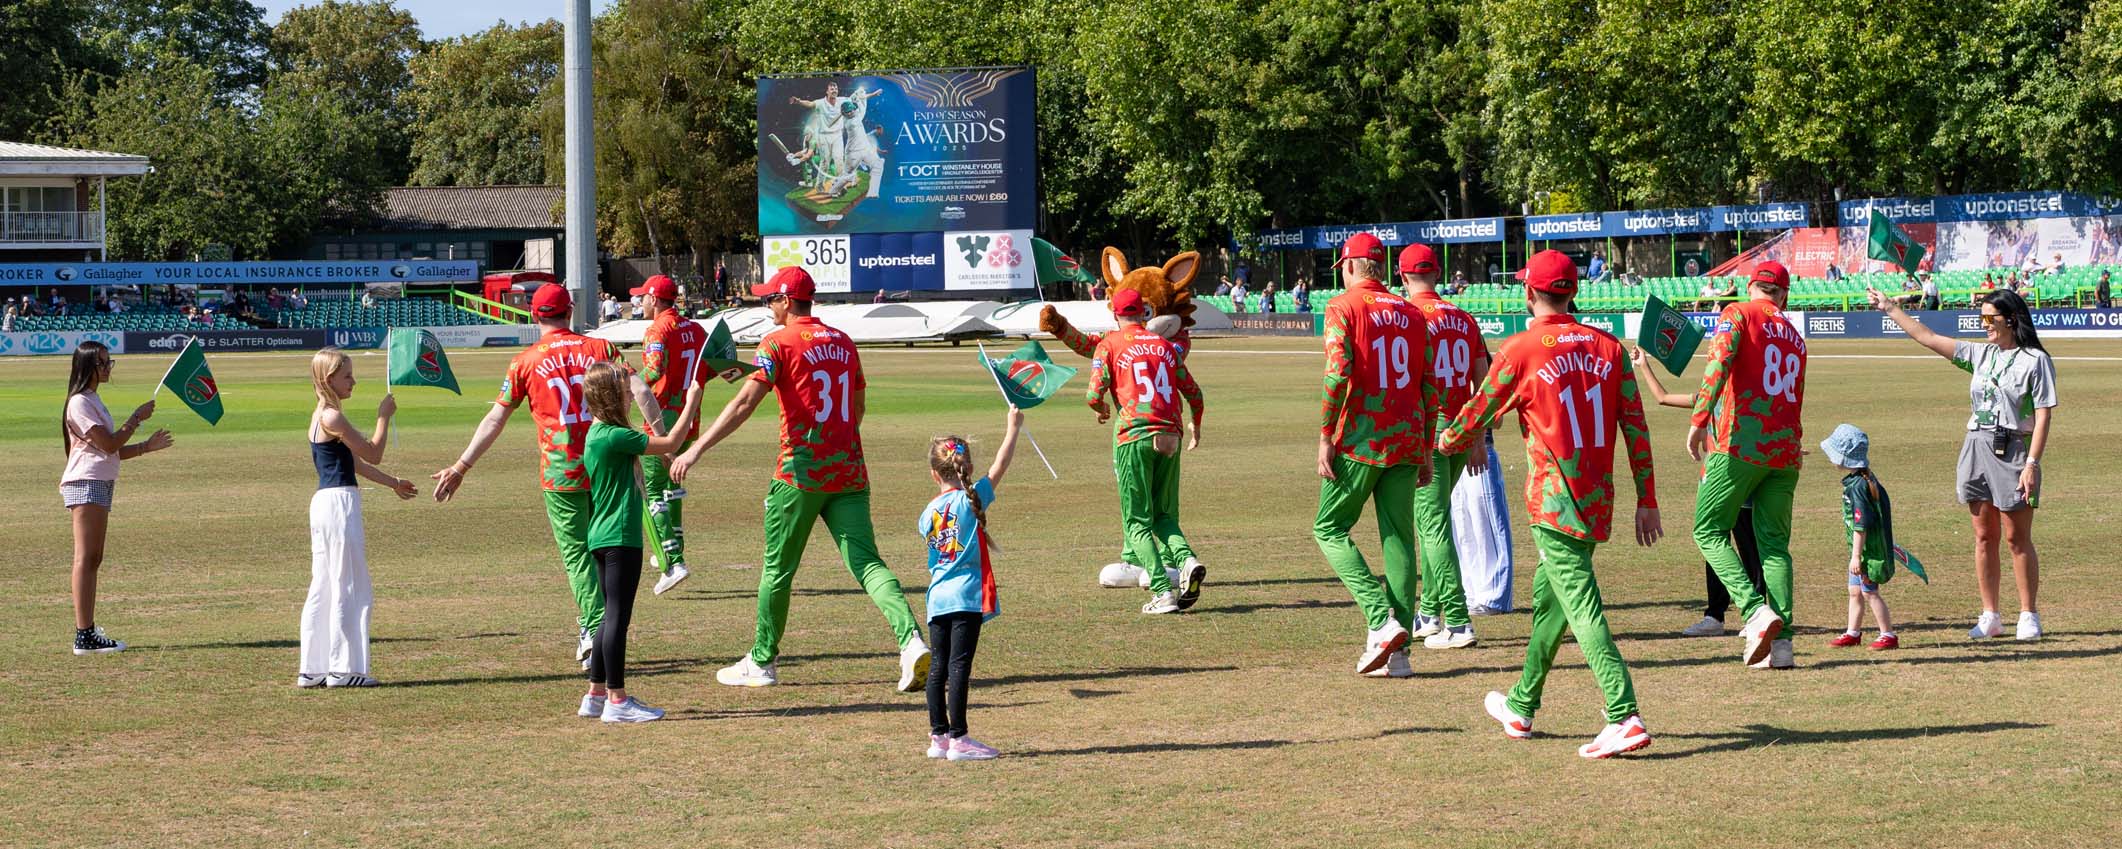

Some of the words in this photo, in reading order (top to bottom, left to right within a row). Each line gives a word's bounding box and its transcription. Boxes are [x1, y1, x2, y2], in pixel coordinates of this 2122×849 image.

[914, 111, 934, 120] END
[947, 110, 986, 120] SEASON
[895, 118, 1006, 145] AWARDS
[909, 164, 941, 177] OCT
[926, 194, 965, 203] AVAILABLE
[989, 193, 1008, 201] £60
[1965, 194, 2063, 217] uptonsteel
[1624, 212, 1699, 231] uptonsteel
[1724, 205, 1804, 227] uptonsteel
[1421, 220, 1497, 241] uptonsteel
[1529, 217, 1601, 237] uptonsteel
[805, 239, 847, 266] 365
[859, 254, 936, 269] uptonsteel
[1795, 251, 1835, 261] ELECTRIC
[83, 268, 143, 282] Gallagher
[155, 267, 191, 279] YOUR
[197, 266, 240, 278] LOCAL
[246, 266, 321, 278] INSURANCE
[327, 266, 379, 277] BROKER
[416, 265, 471, 279] Gallagher
[1276, 321, 1311, 329] COMPANY
[1370, 309, 1409, 330] WOOD
[1427, 314, 1469, 336] WALKER
[1661, 311, 1687, 330] FOXES
[1809, 320, 1846, 331] FREETHS
[1958, 319, 1986, 330] FREE
[2032, 313, 2059, 326] EASY
[2061, 313, 2088, 326] WAY
[2090, 312, 2107, 326] TO
[208, 338, 216, 347] &
[219, 337, 264, 347] SLATTER
[266, 337, 303, 347] Opticians
[351, 332, 377, 342] WBR
[549, 339, 583, 348] dafabet
[1557, 333, 1594, 344] dafabet
[1762, 322, 1806, 355] SCRIVEN
[803, 343, 851, 365] WRIGHT
[1116, 343, 1176, 370] HANDSCOMB
[1372, 335, 1411, 389] 19
[1434, 338, 1470, 388] 49
[535, 352, 596, 378] HOLLAND
[681, 348, 696, 390] 7
[1536, 352, 1613, 386] BUDINGER
[1763, 343, 1800, 403] 88
[1133, 361, 1172, 404] 54
[546, 374, 594, 426] 22
[812, 369, 849, 422] 31
[1559, 383, 1605, 449] 11
